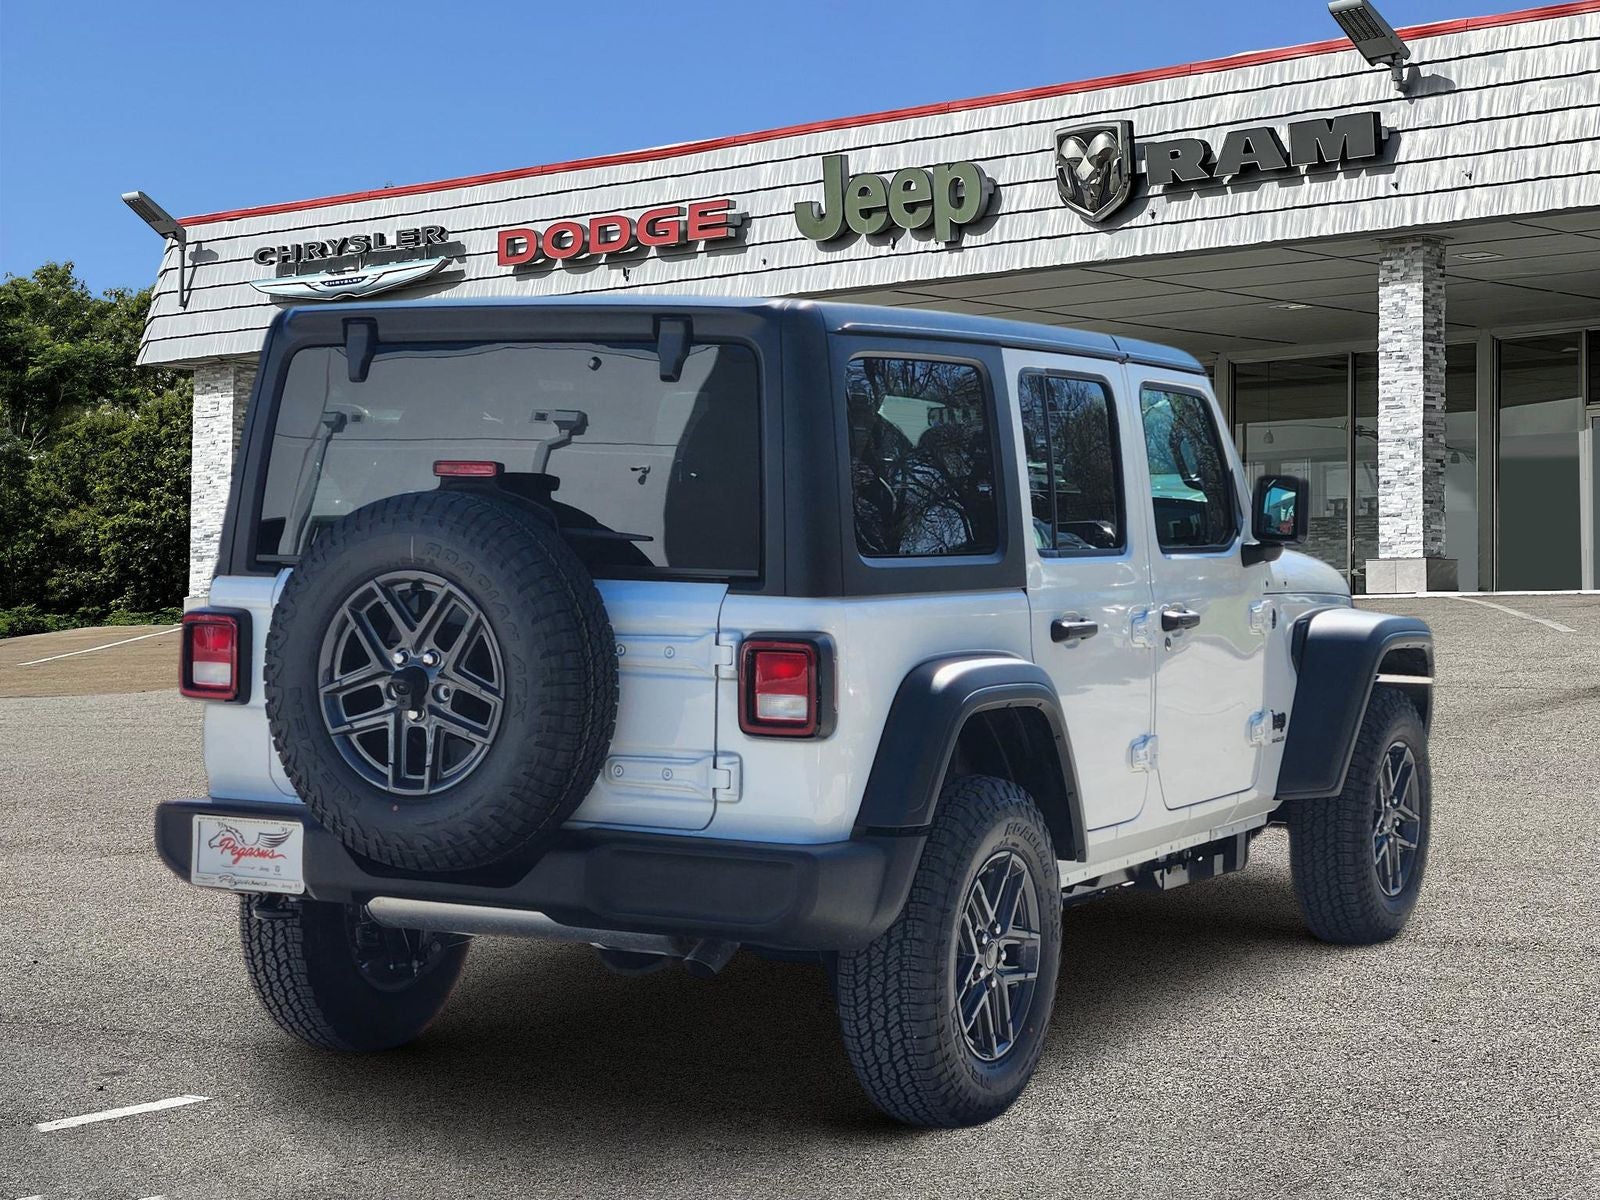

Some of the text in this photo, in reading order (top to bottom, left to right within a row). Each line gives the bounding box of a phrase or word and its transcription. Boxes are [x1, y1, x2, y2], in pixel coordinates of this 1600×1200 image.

[1145, 111, 1382, 187] RAM
[795, 155, 984, 242] Jeep
[254, 225, 447, 265] CHRYSLER
[497, 199, 733, 266] DODGE
[219, 837, 288, 865] Pegasus
